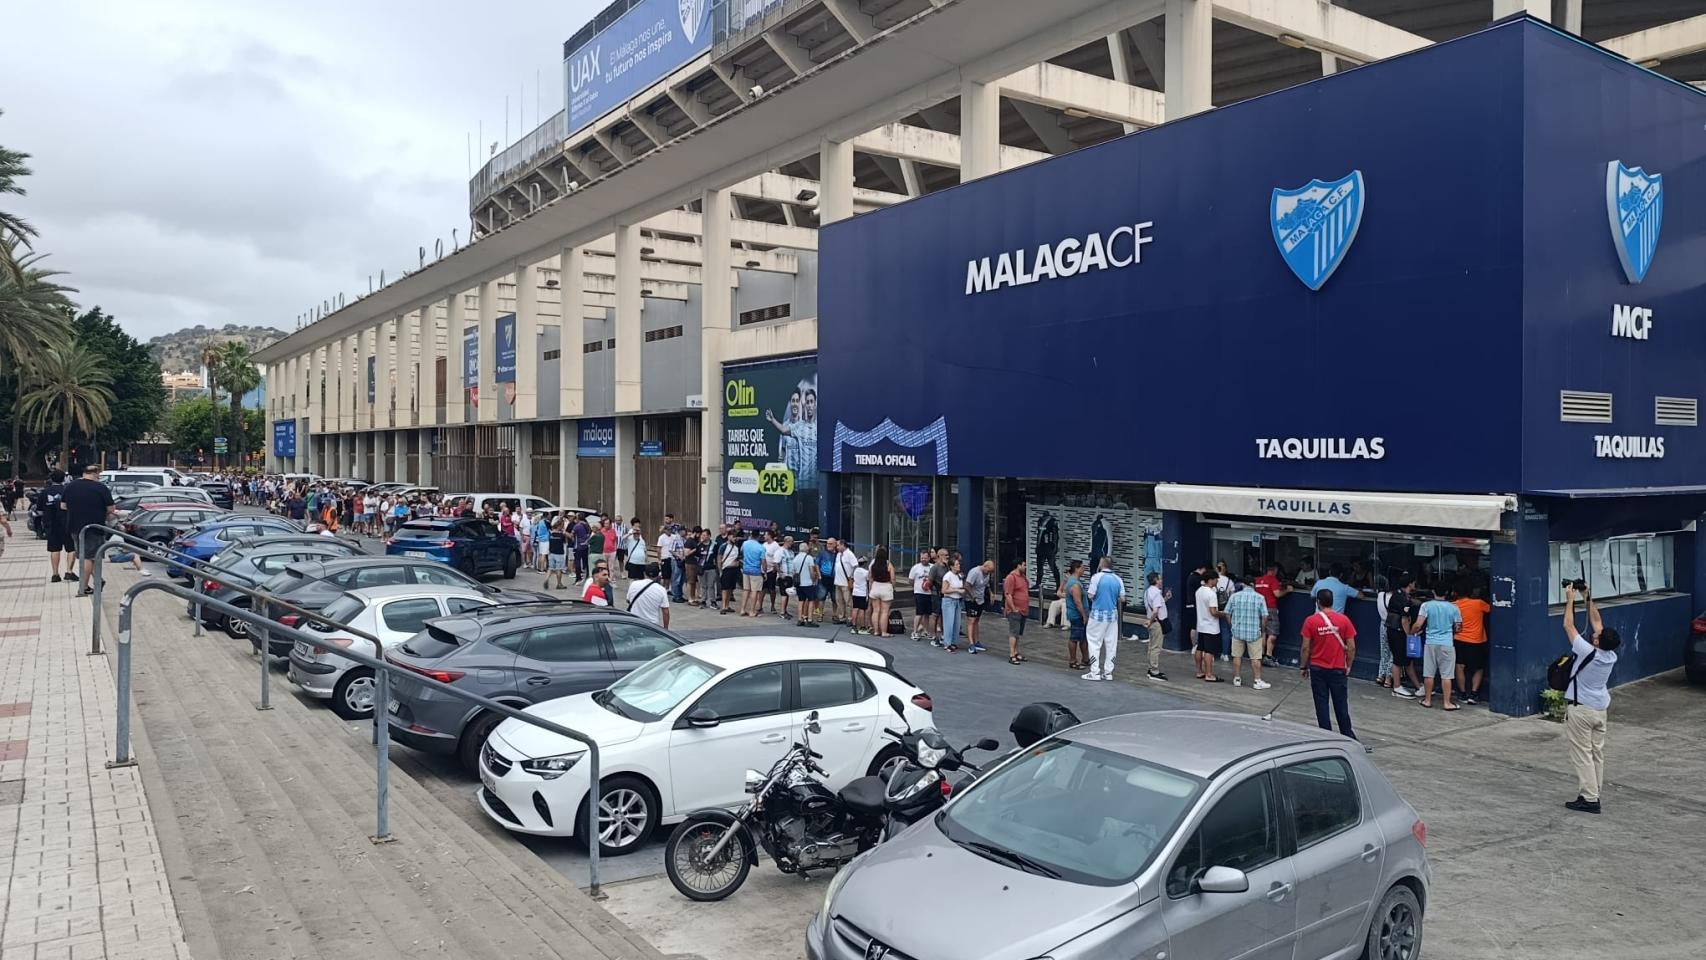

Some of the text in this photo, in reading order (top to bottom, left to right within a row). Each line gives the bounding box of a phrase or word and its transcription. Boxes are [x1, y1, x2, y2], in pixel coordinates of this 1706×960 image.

[605, 30, 672, 84] tu futuro nos inspira
[571, 45, 601, 93] UAX
[1612, 304, 1652, 340] MCF
[726, 379, 755, 406] Olin
[583, 422, 613, 446] málaga
[728, 428, 764, 442] TARIFAS QUE
[728, 443, 769, 457] VAN DE CARA.
[1256, 437, 1385, 460] TAQUILLAS
[1594, 435, 1665, 459] TAQUILLAS
[855, 454, 917, 467] TIENDA OFICIAL
[763, 472, 788, 493] 20€
[1257, 498, 1351, 515] TAQUILLAS
